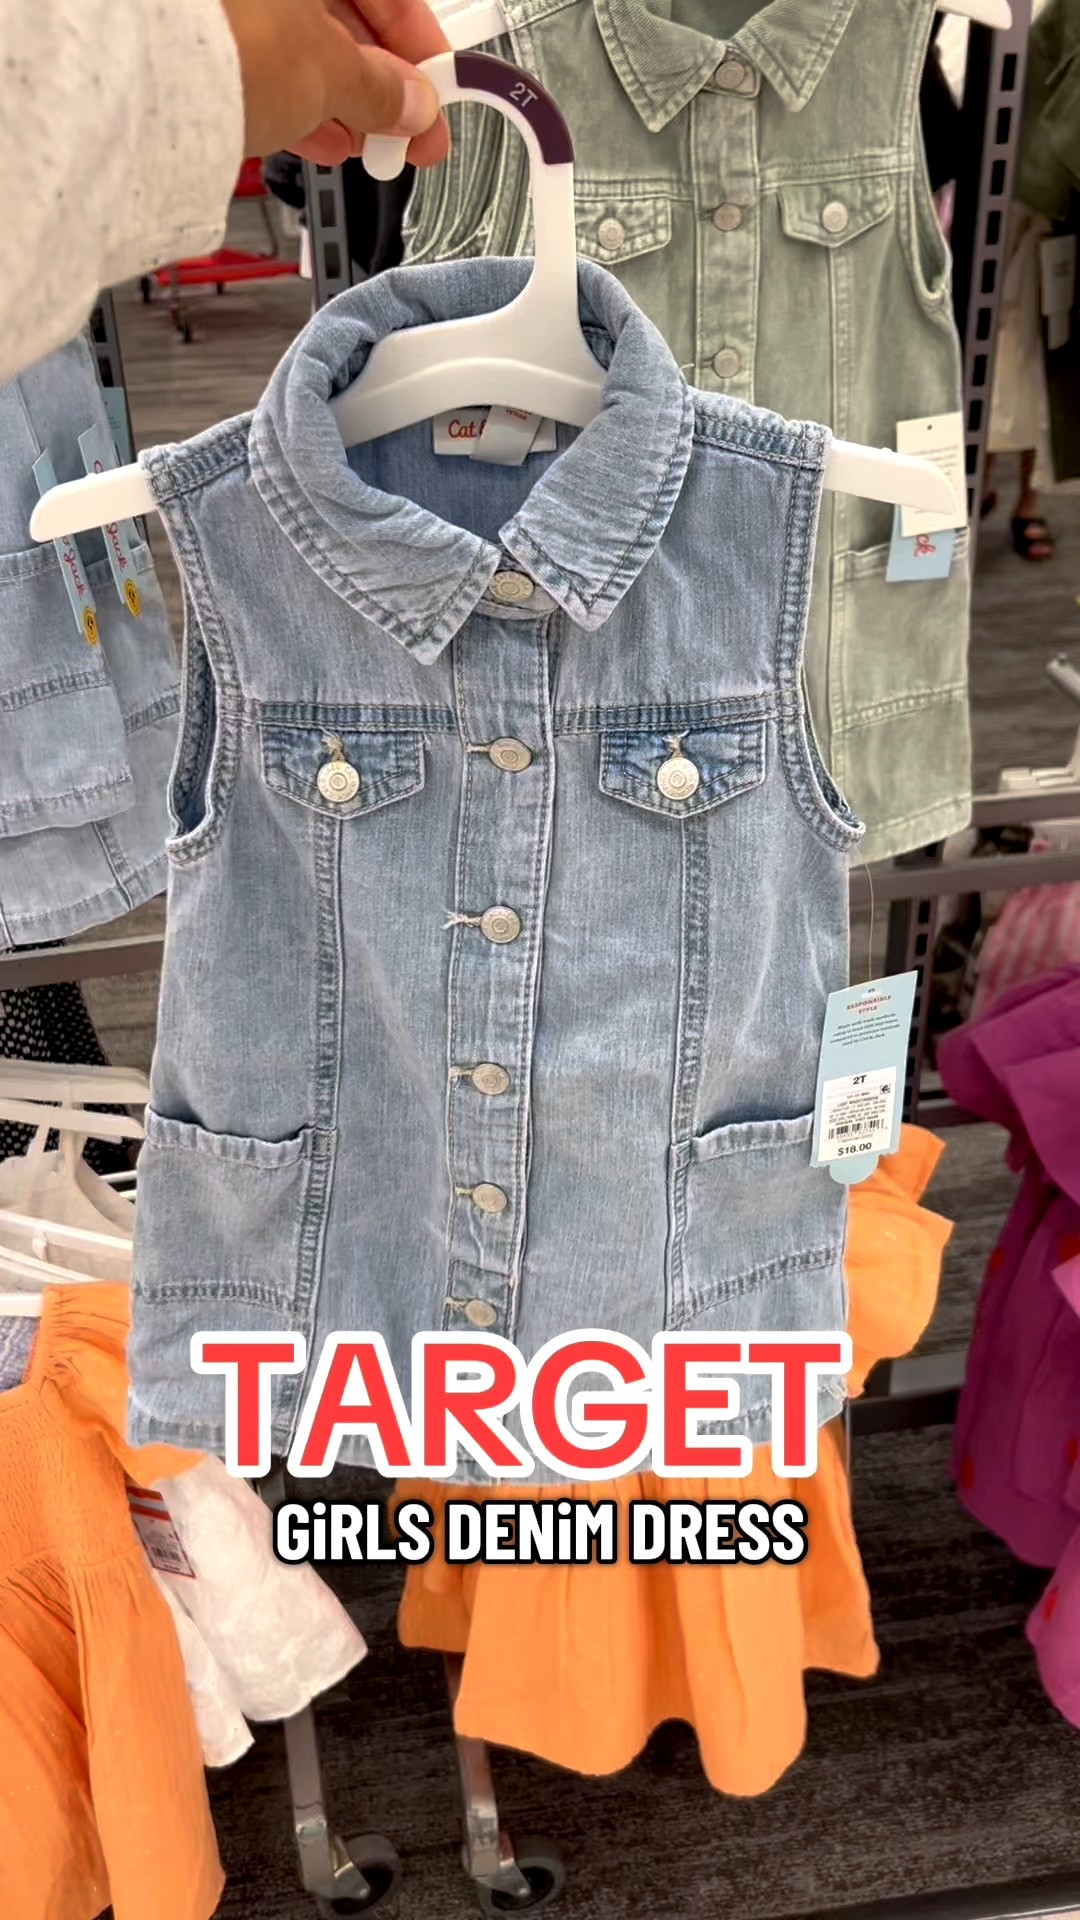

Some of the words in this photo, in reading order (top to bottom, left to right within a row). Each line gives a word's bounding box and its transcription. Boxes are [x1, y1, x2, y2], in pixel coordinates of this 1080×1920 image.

[509, 82, 539, 107] 2T
[448, 420, 477, 438] Cat
[63, 547, 87, 599] Jack
[846, 995, 891, 1009] RESPONSIBLE
[858, 1005, 878, 1014] STYLE
[853, 1075, 867, 1085] 2T
[838, 1142, 872, 1156] $18.00
